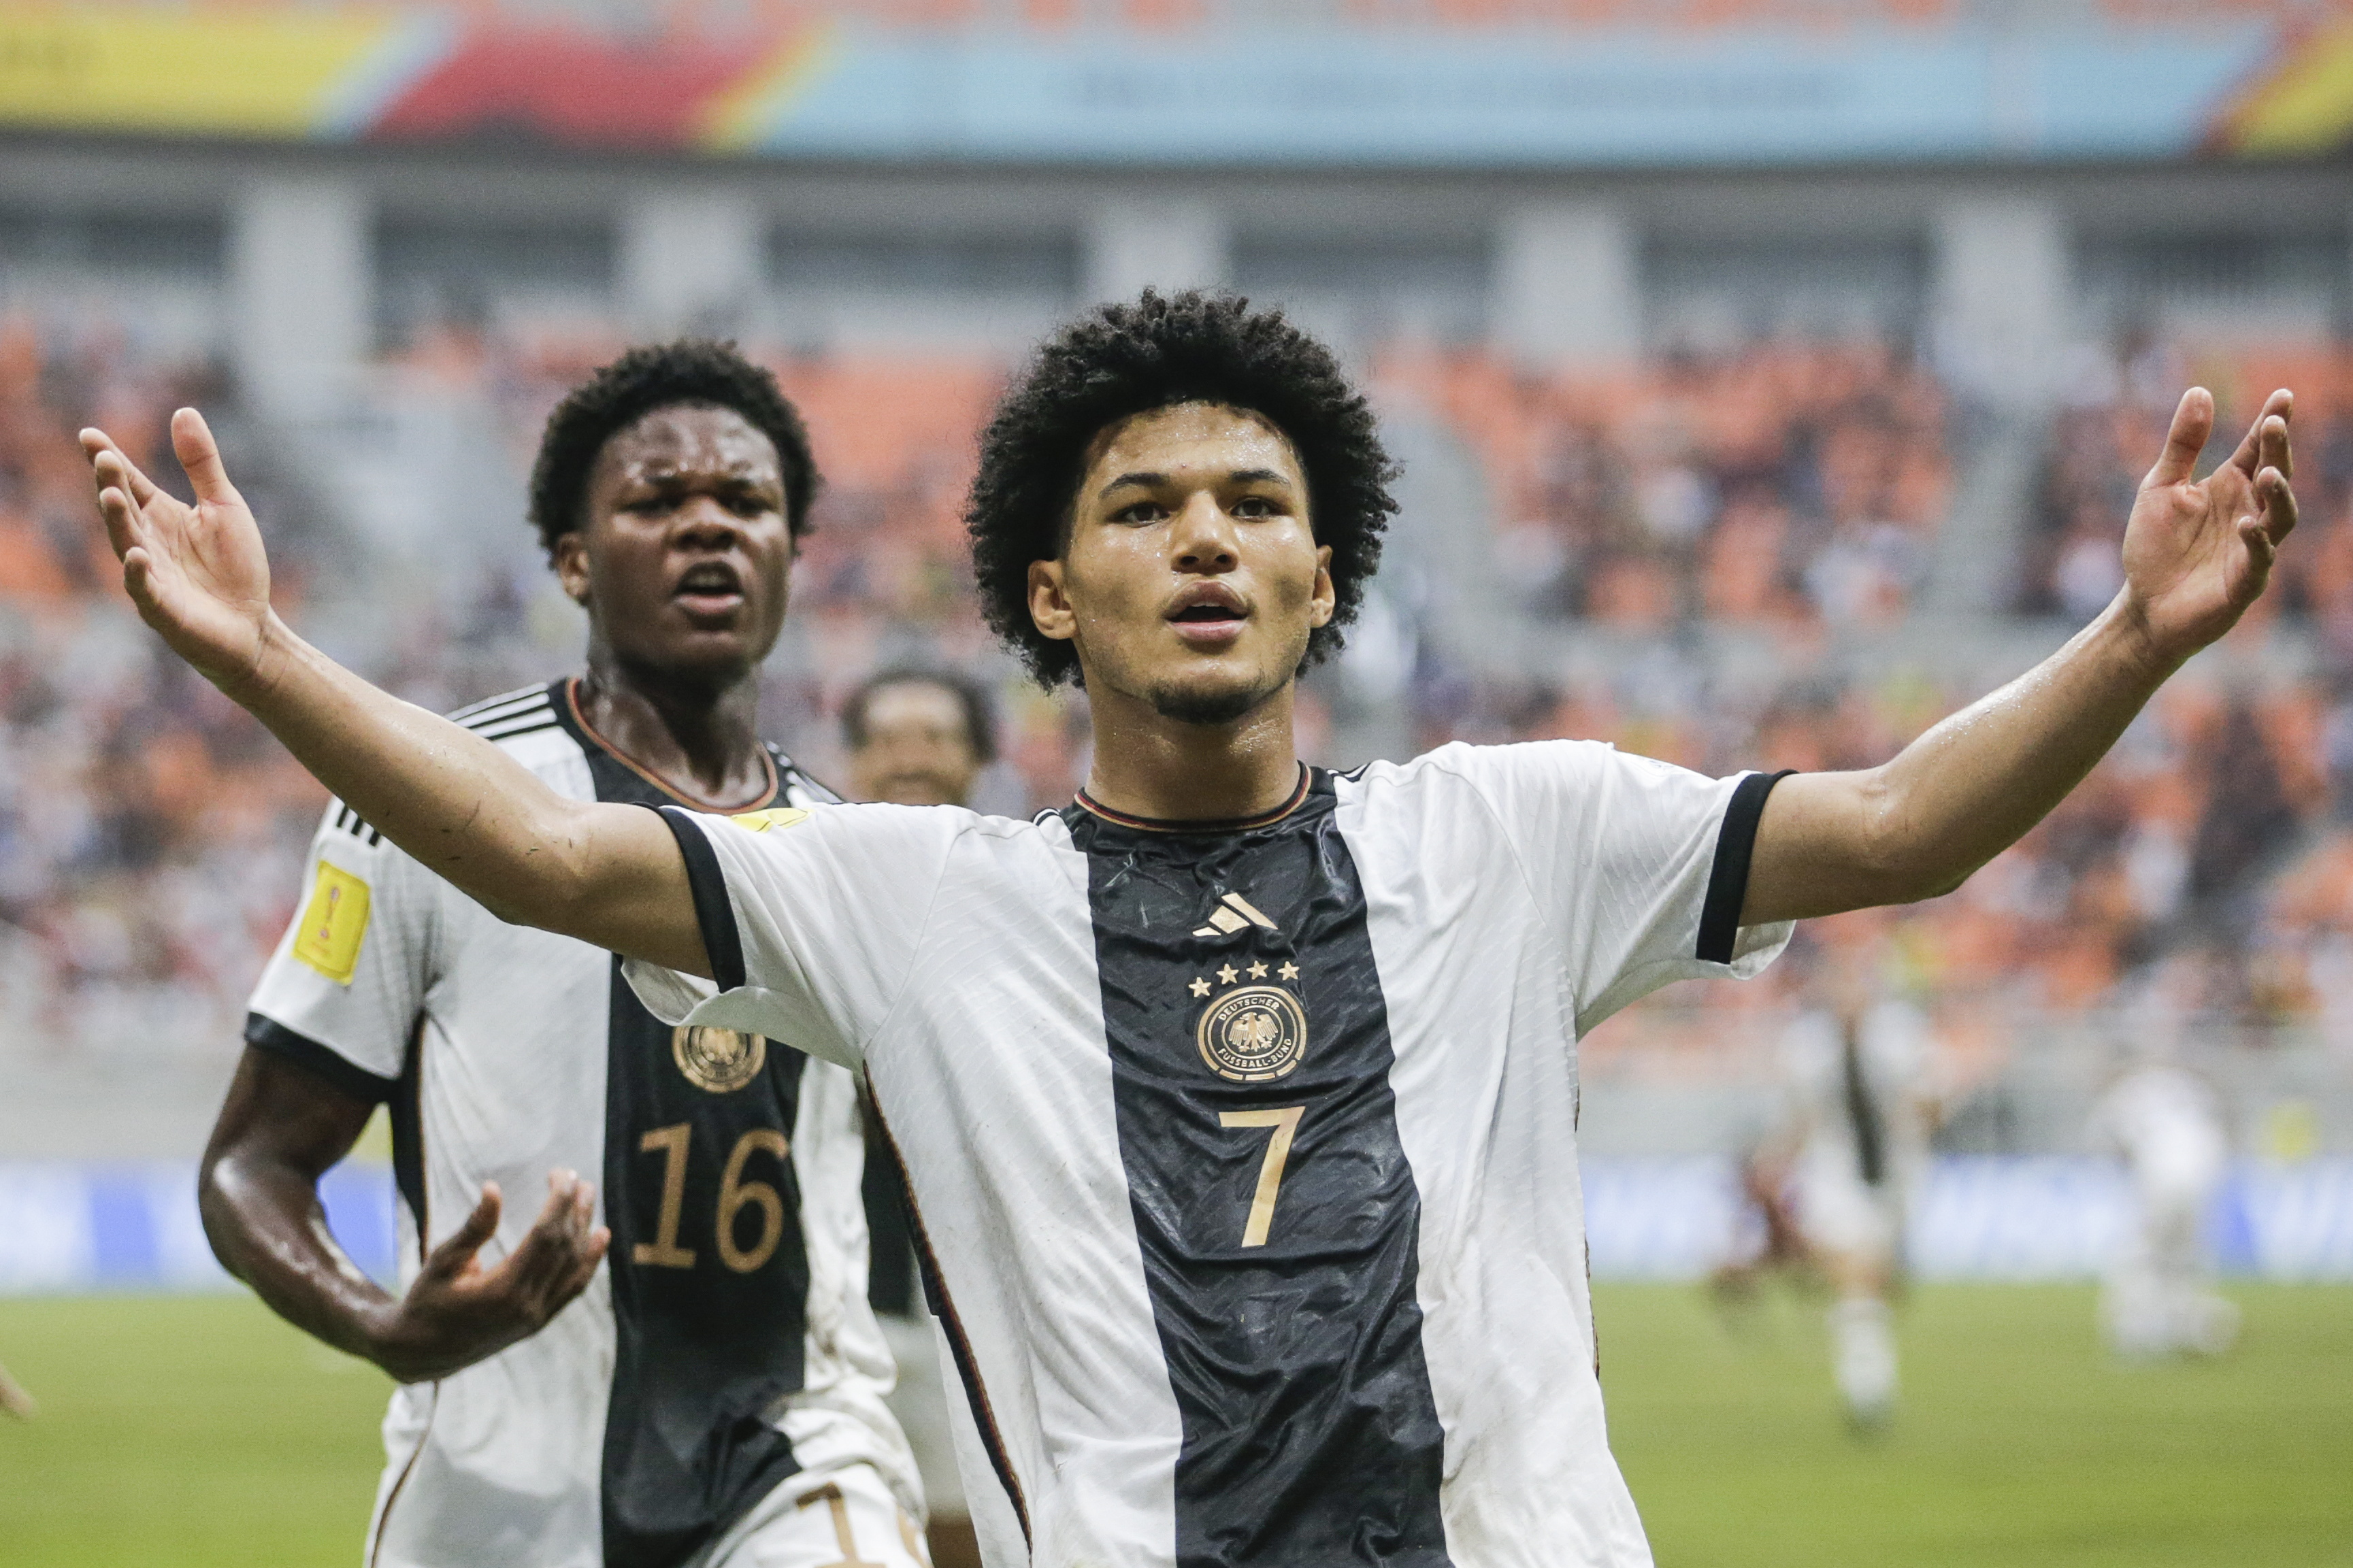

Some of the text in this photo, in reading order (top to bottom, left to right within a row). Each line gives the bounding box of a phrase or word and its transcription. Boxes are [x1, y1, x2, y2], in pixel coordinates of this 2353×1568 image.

[1218, 998, 1280, 1020] DEUTSCHER
[1218, 1039, 1291, 1067] FUSSBALL-BUND
[632, 1122, 791, 1274] 16
[1219, 1106, 1306, 1248] 7
